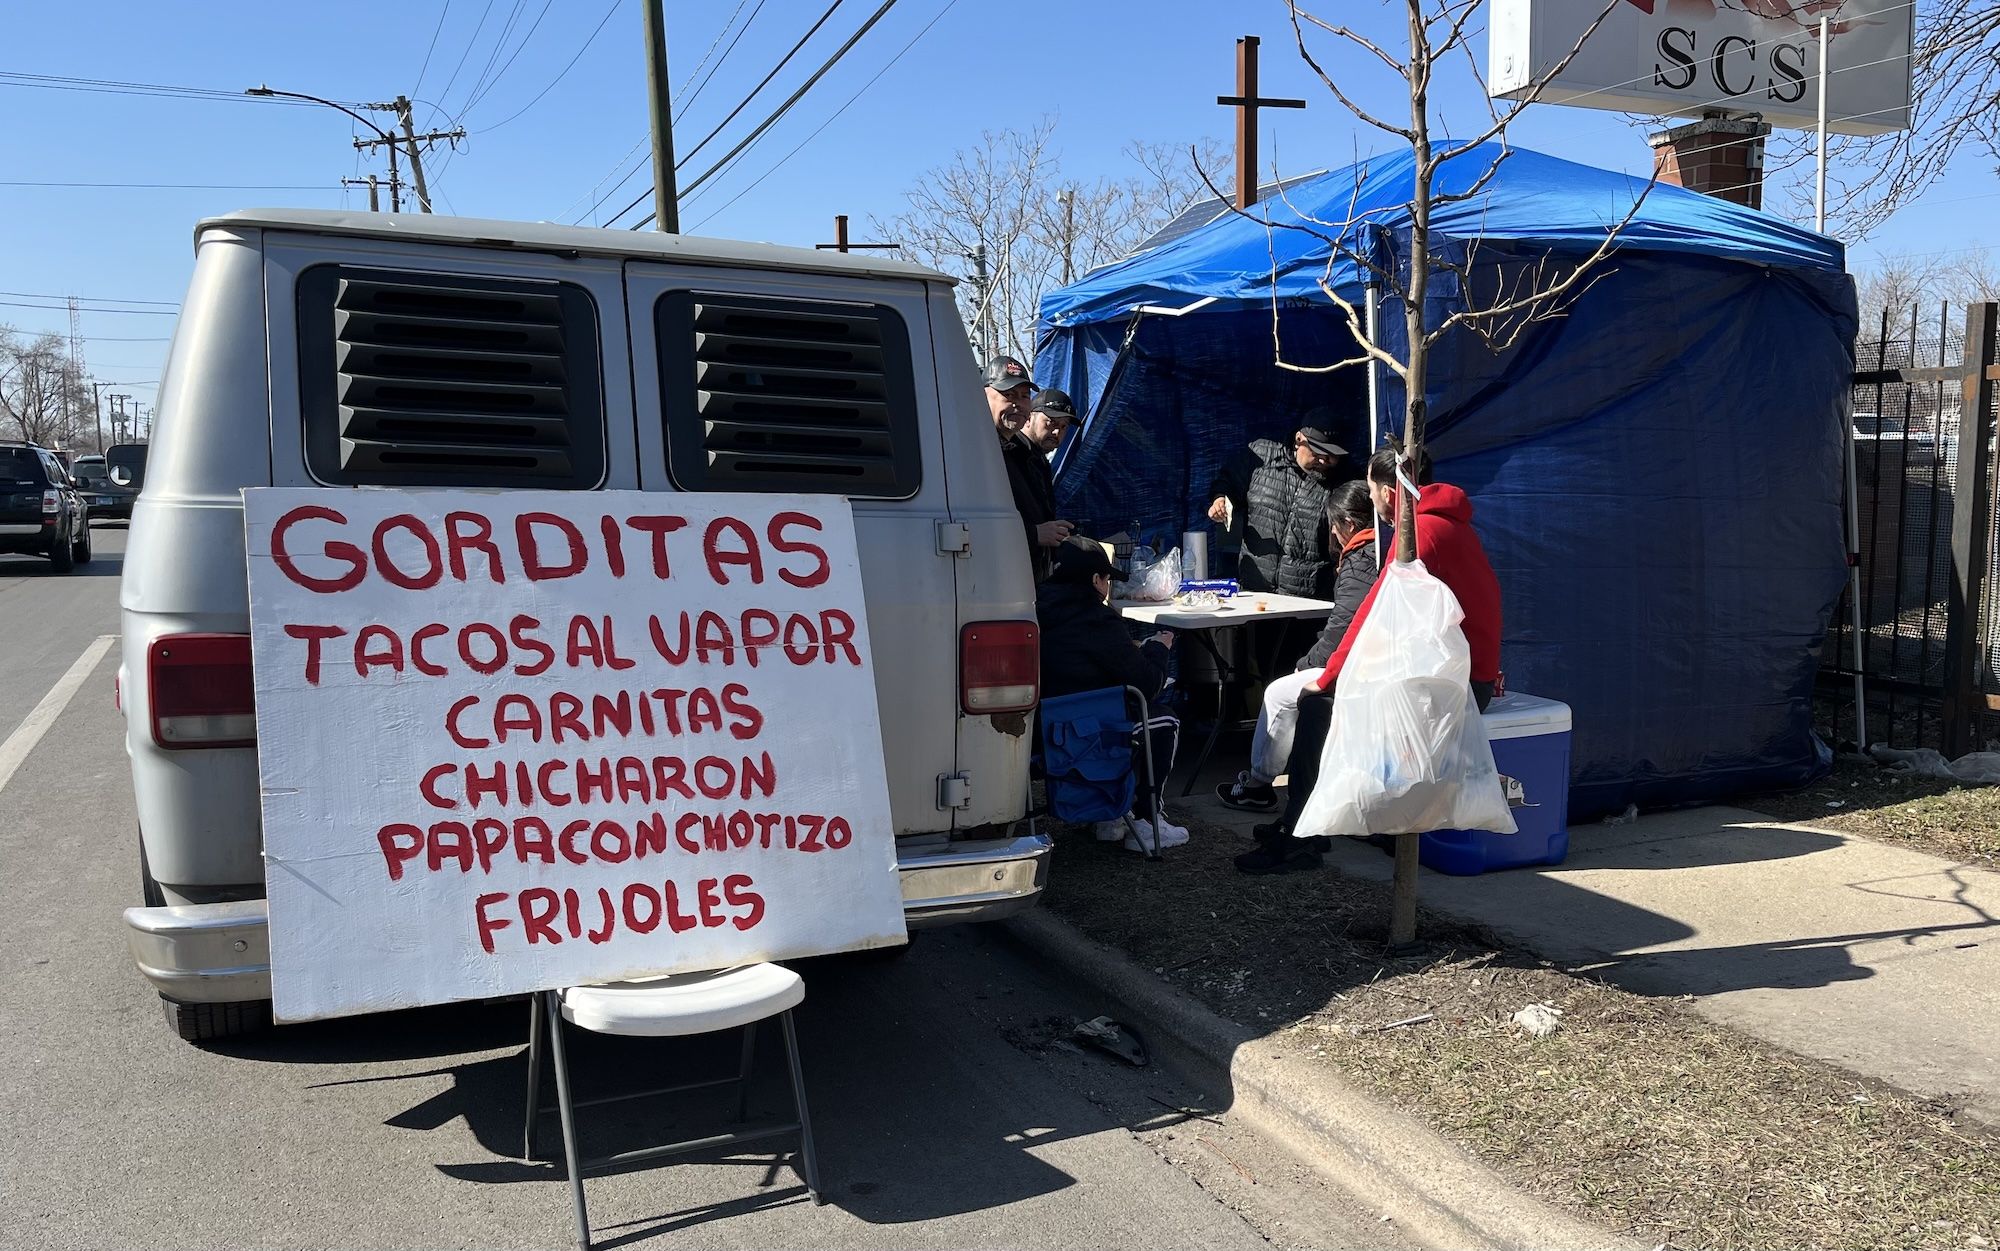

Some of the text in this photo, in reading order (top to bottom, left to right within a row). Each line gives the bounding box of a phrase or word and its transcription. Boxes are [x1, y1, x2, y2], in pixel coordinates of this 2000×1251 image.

[1654, 27, 1806, 103] SCS
[272, 506, 829, 592] GORDITAS
[284, 608, 861, 684] TACOS AL VAPOR
[447, 683, 763, 749] CARNITAS
[420, 752, 776, 808] CHICHARON
[476, 874, 766, 953] FRIJOLES
